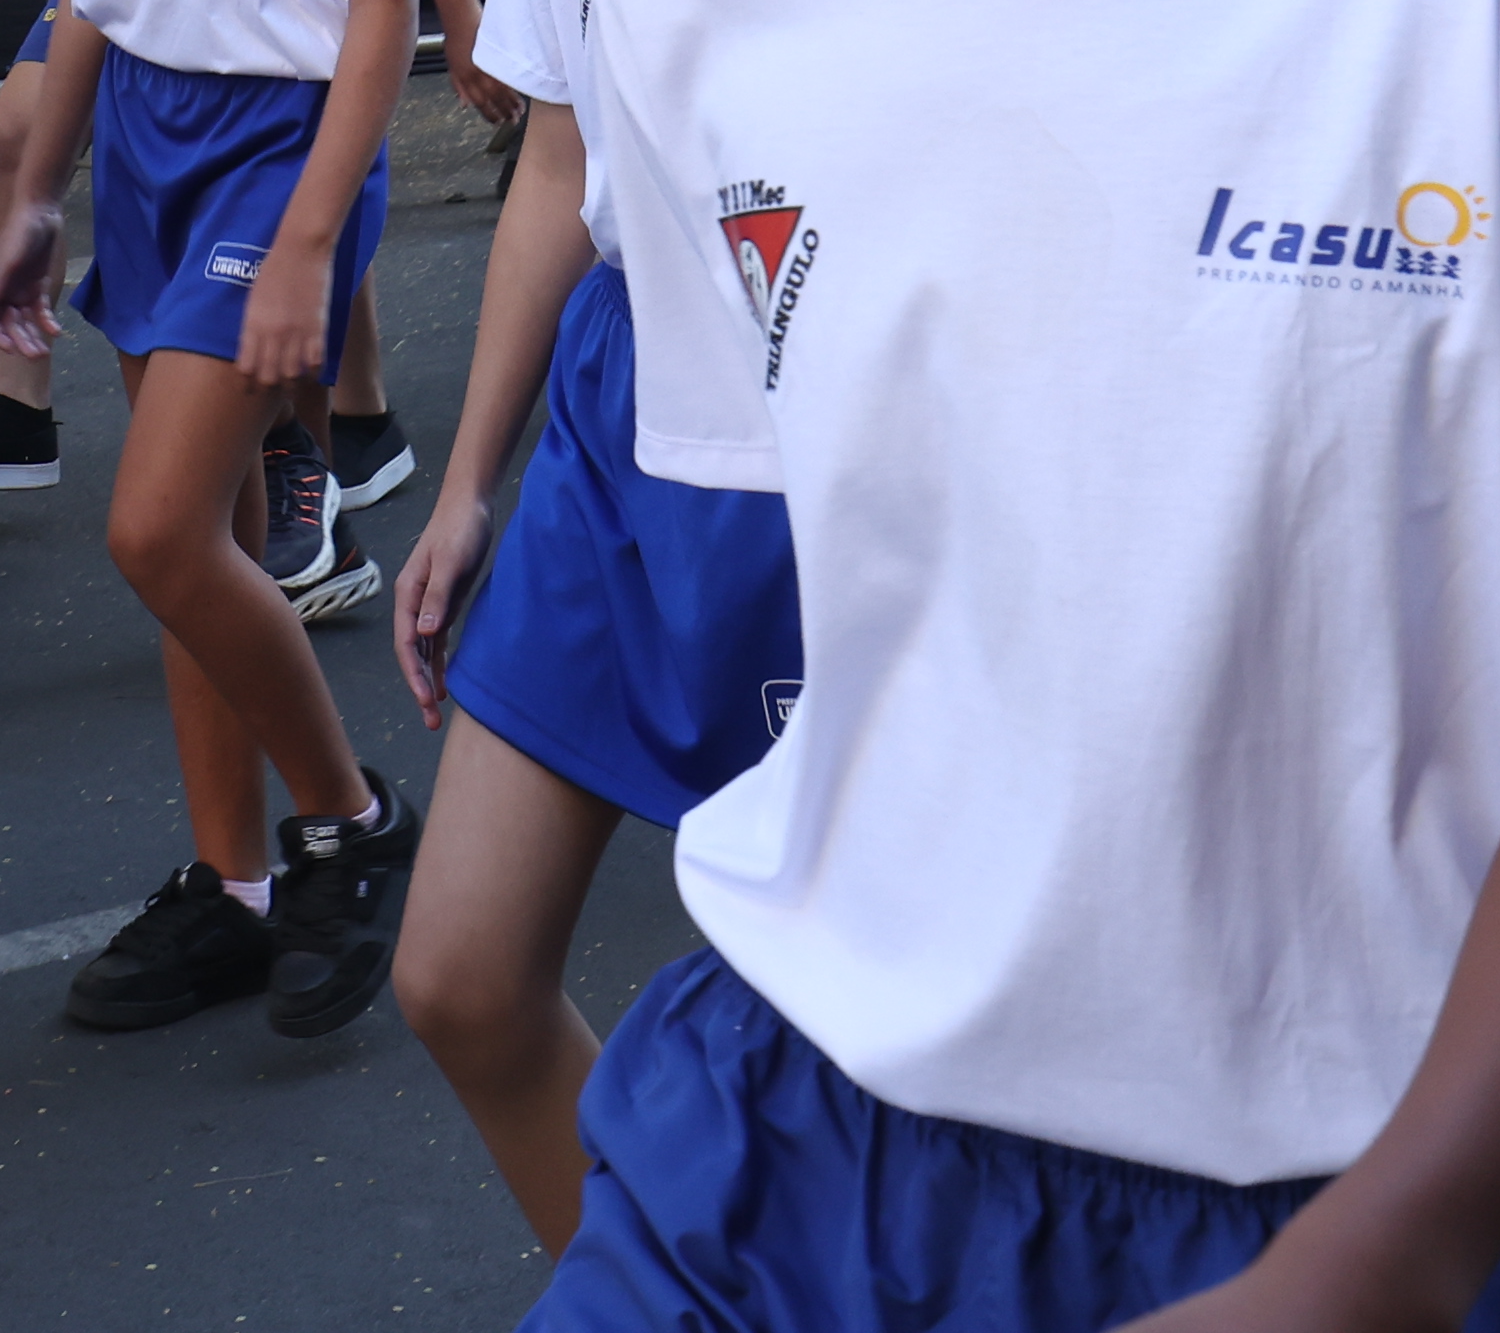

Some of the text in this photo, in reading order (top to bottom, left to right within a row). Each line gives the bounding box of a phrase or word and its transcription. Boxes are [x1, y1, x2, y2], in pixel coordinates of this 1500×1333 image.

[1197, 187, 1393, 270] Icasu
[1198, 267, 1465, 300] PREPARANDO O AMANHÃ
